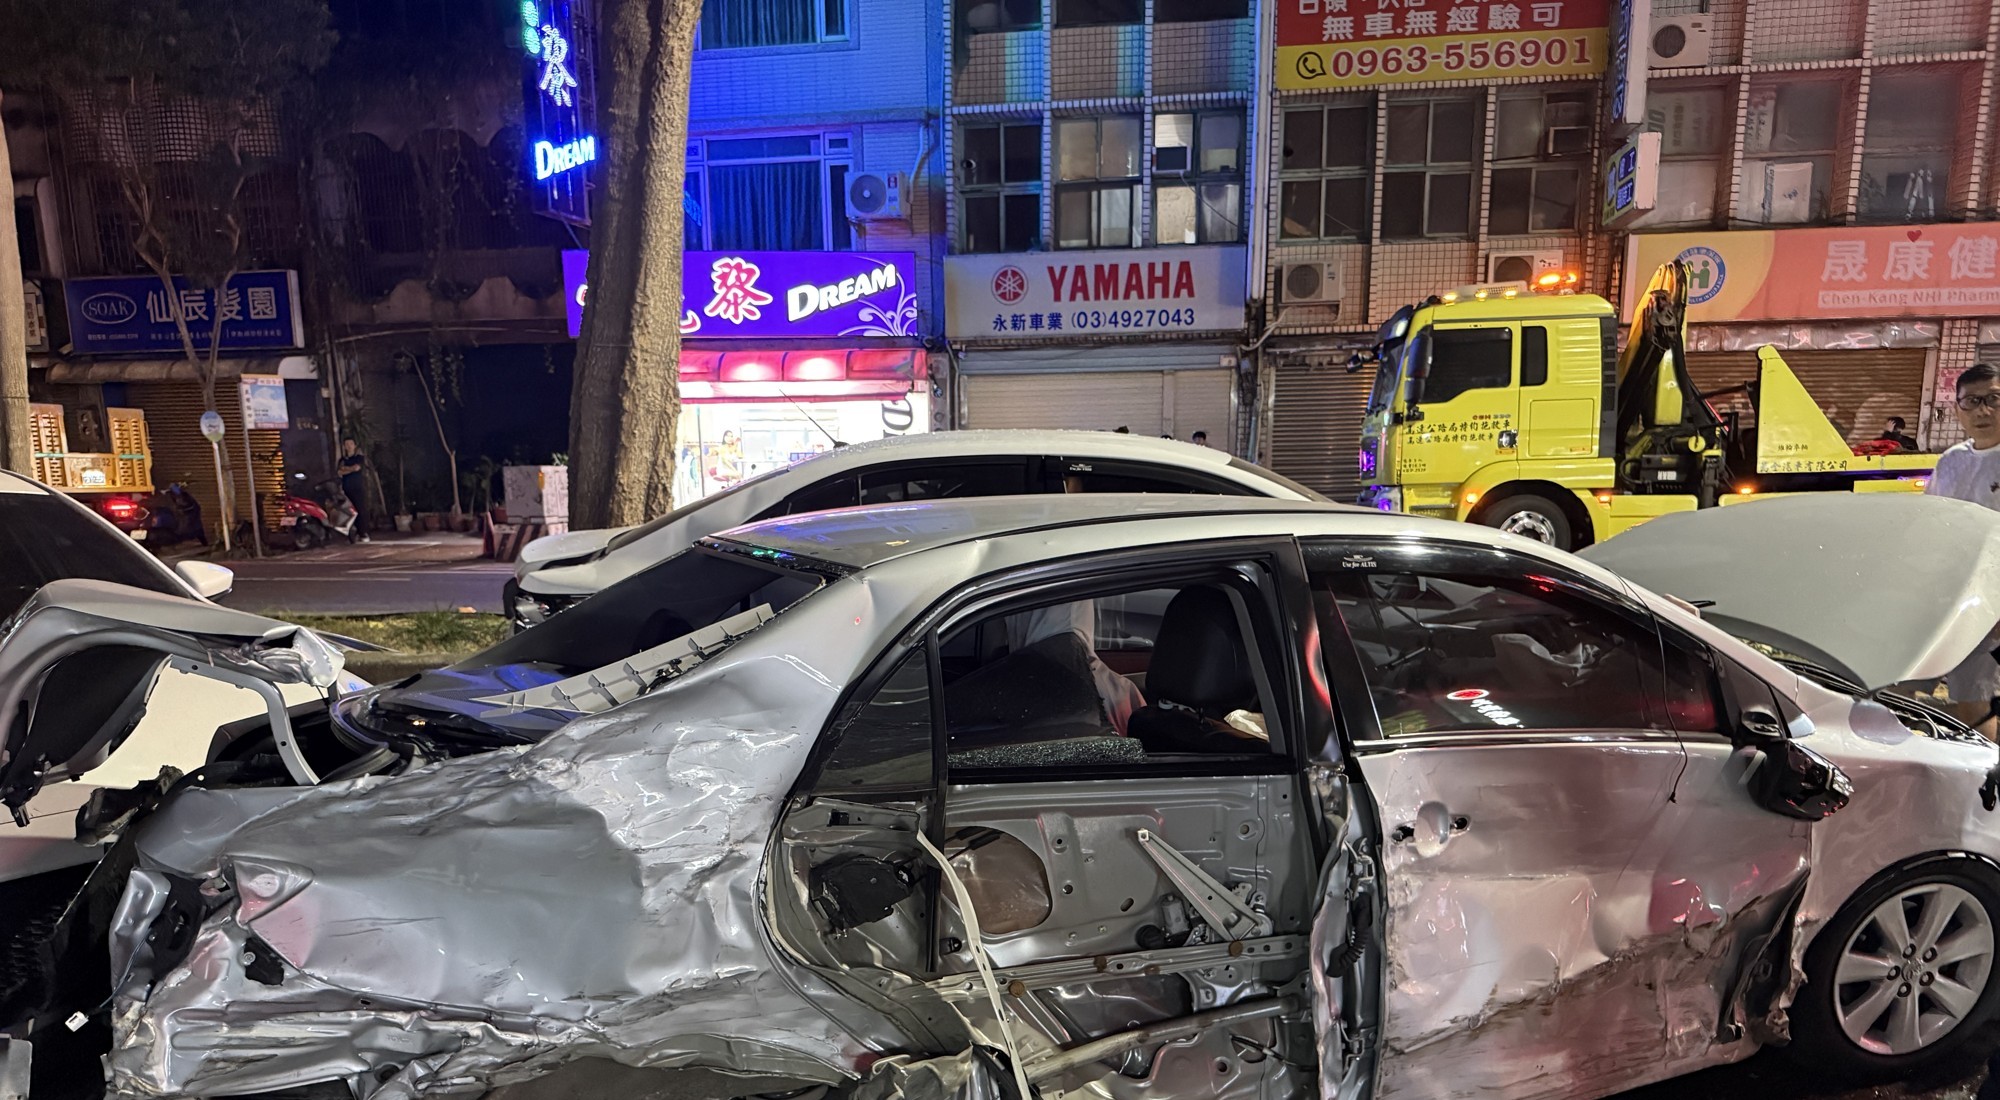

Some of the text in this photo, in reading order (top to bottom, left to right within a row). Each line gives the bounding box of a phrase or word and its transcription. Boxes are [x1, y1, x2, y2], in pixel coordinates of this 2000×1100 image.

[1331, 37, 1591, 78] 0963-556901
[535, 136, 595, 180] DREAM
[1821, 236, 2000, 283] 晟康健
[787, 263, 897, 323] DREAM
[1047, 261, 1195, 302] YAMAHA
[88, 301, 128, 317] SOAK
[992, 308, 1195, 332] 永新車業 (03)4927043
